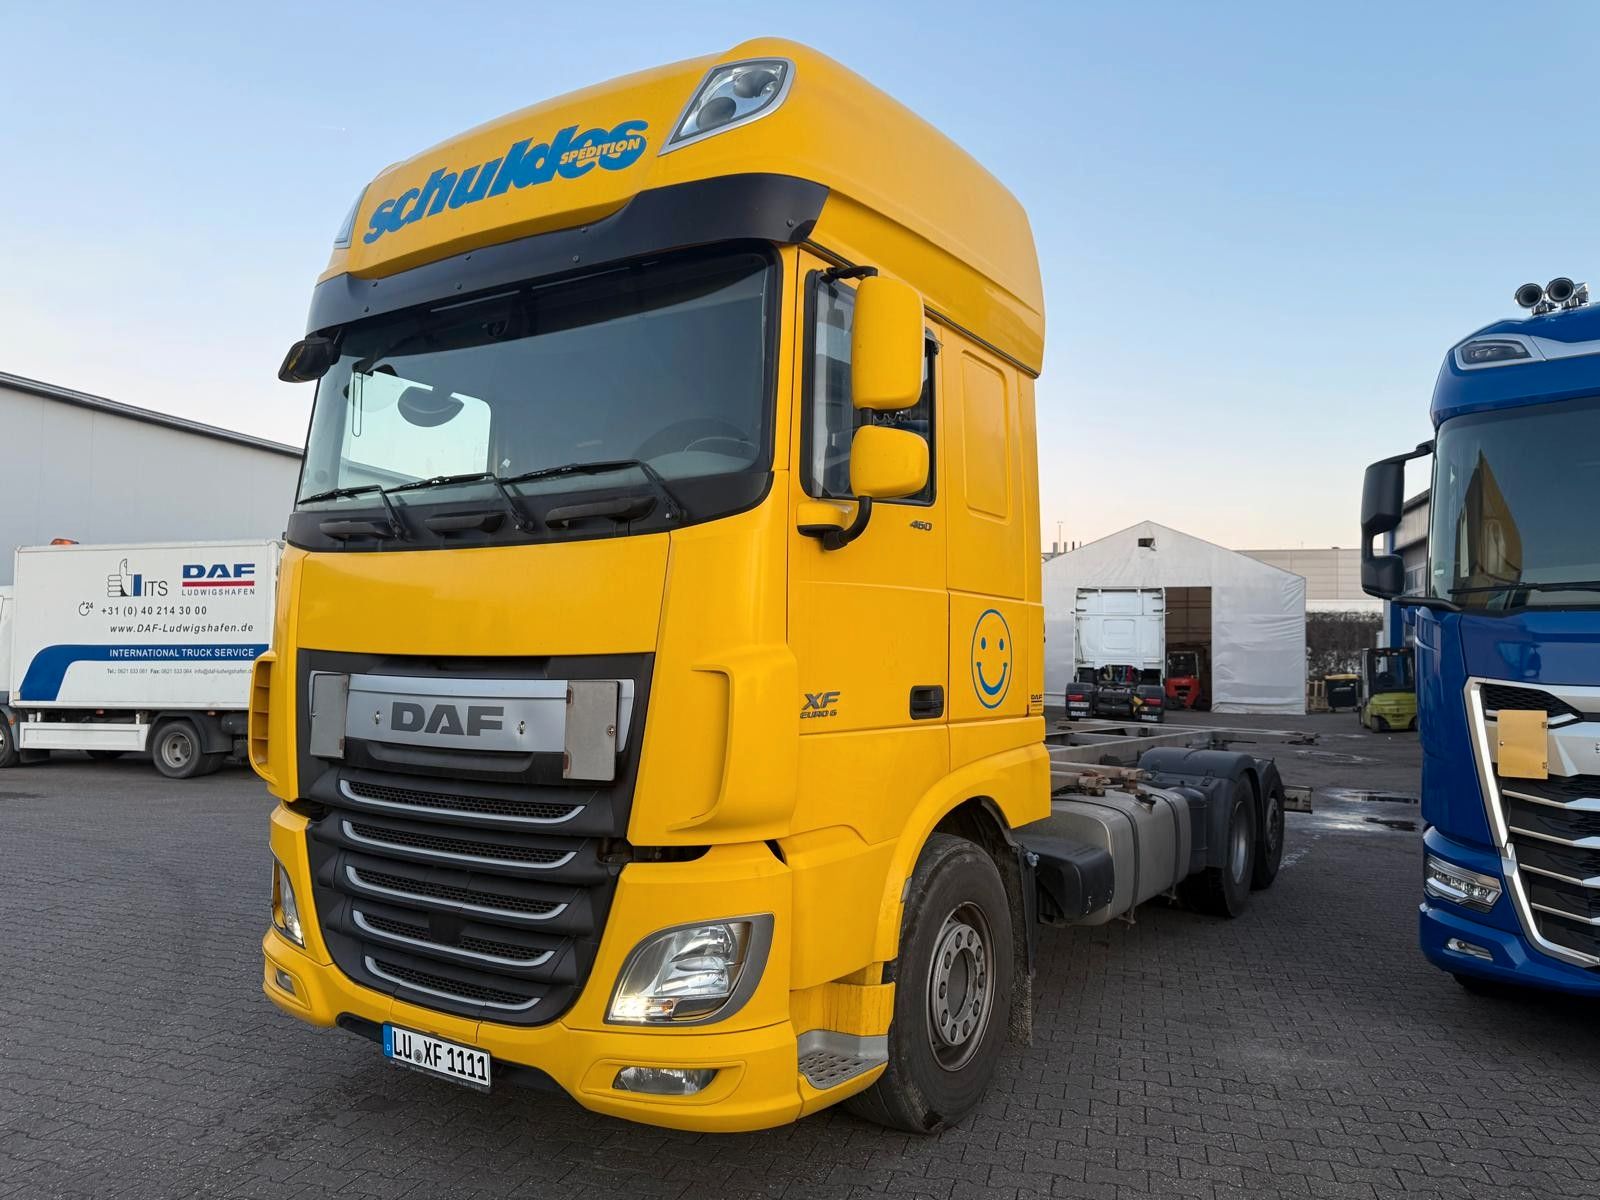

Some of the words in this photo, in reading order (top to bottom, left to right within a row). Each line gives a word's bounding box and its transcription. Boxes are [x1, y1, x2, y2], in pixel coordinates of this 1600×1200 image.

[560, 137, 641, 164] SPEDITION
[909, 520, 933, 531] 460
[182, 563, 255, 579] DAF
[144, 581, 168, 597] ITS
[181, 588, 255, 596] LUDWIGSHAFEN
[85, 601, 94, 609] 24
[101, 606, 119, 615] +31
[123, 606, 137, 617] (0)
[141, 606, 153, 615] 40
[156, 606, 175, 615] 214
[179, 605, 191, 615] 30
[194, 605, 207, 615] 00
[110, 623, 254, 634] www.DAF-Ludwigshafen.de
[109, 648, 179, 657] INTERNATIONAL
[181, 648, 212, 657] TRUCK
[214, 648, 255, 657] SERVICE
[801, 691, 840, 710] XF
[390, 701, 505, 737] DAF
[800, 710, 827, 719] EURO
[829, 709, 837, 717] 6
[393, 1030, 412, 1059] LU
[423, 1040, 442, 1068] XF
[447, 1047, 487, 1081] 1111
